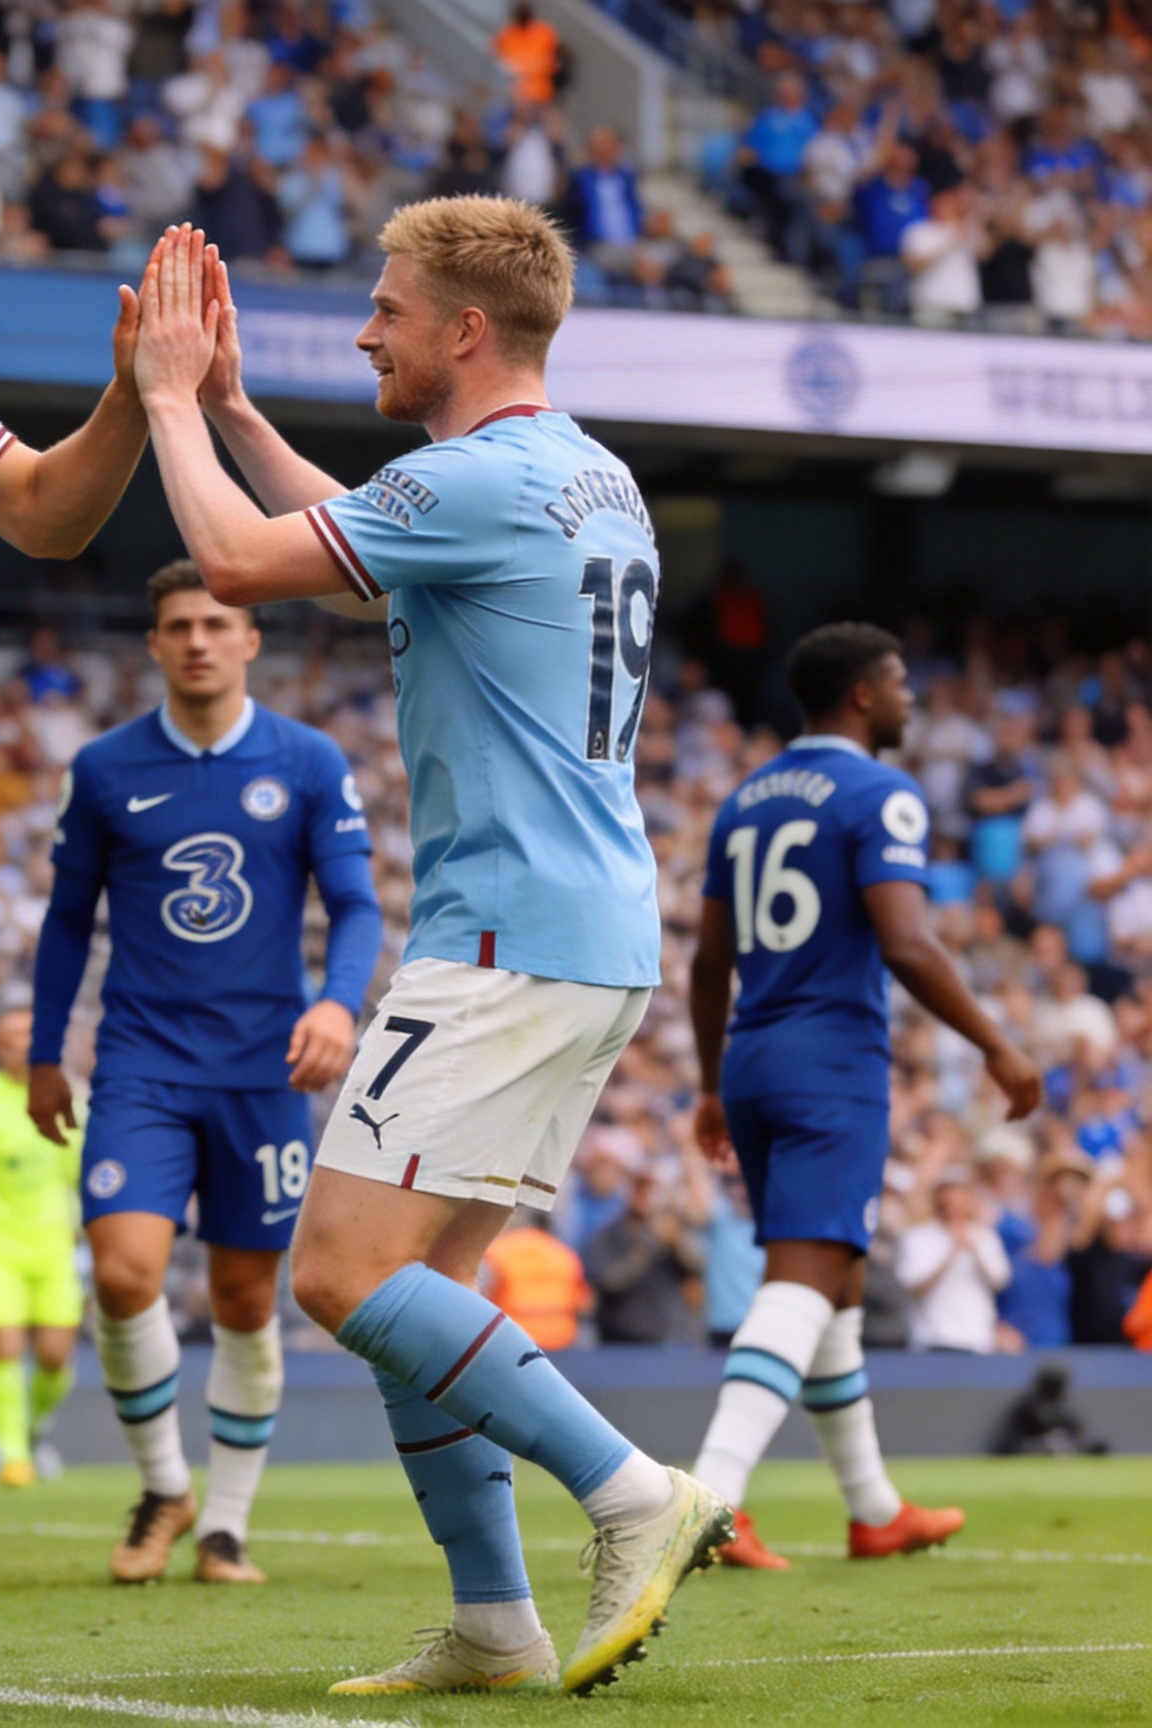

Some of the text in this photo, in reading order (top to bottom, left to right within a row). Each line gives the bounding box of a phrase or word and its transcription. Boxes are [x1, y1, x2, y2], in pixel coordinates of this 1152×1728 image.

[578, 557, 655, 764] 19
[162, 832, 253, 943] 3
[726, 819, 822, 955] 16
[365, 1015, 436, 1101] 7
[255, 1140, 310, 1204] 18
